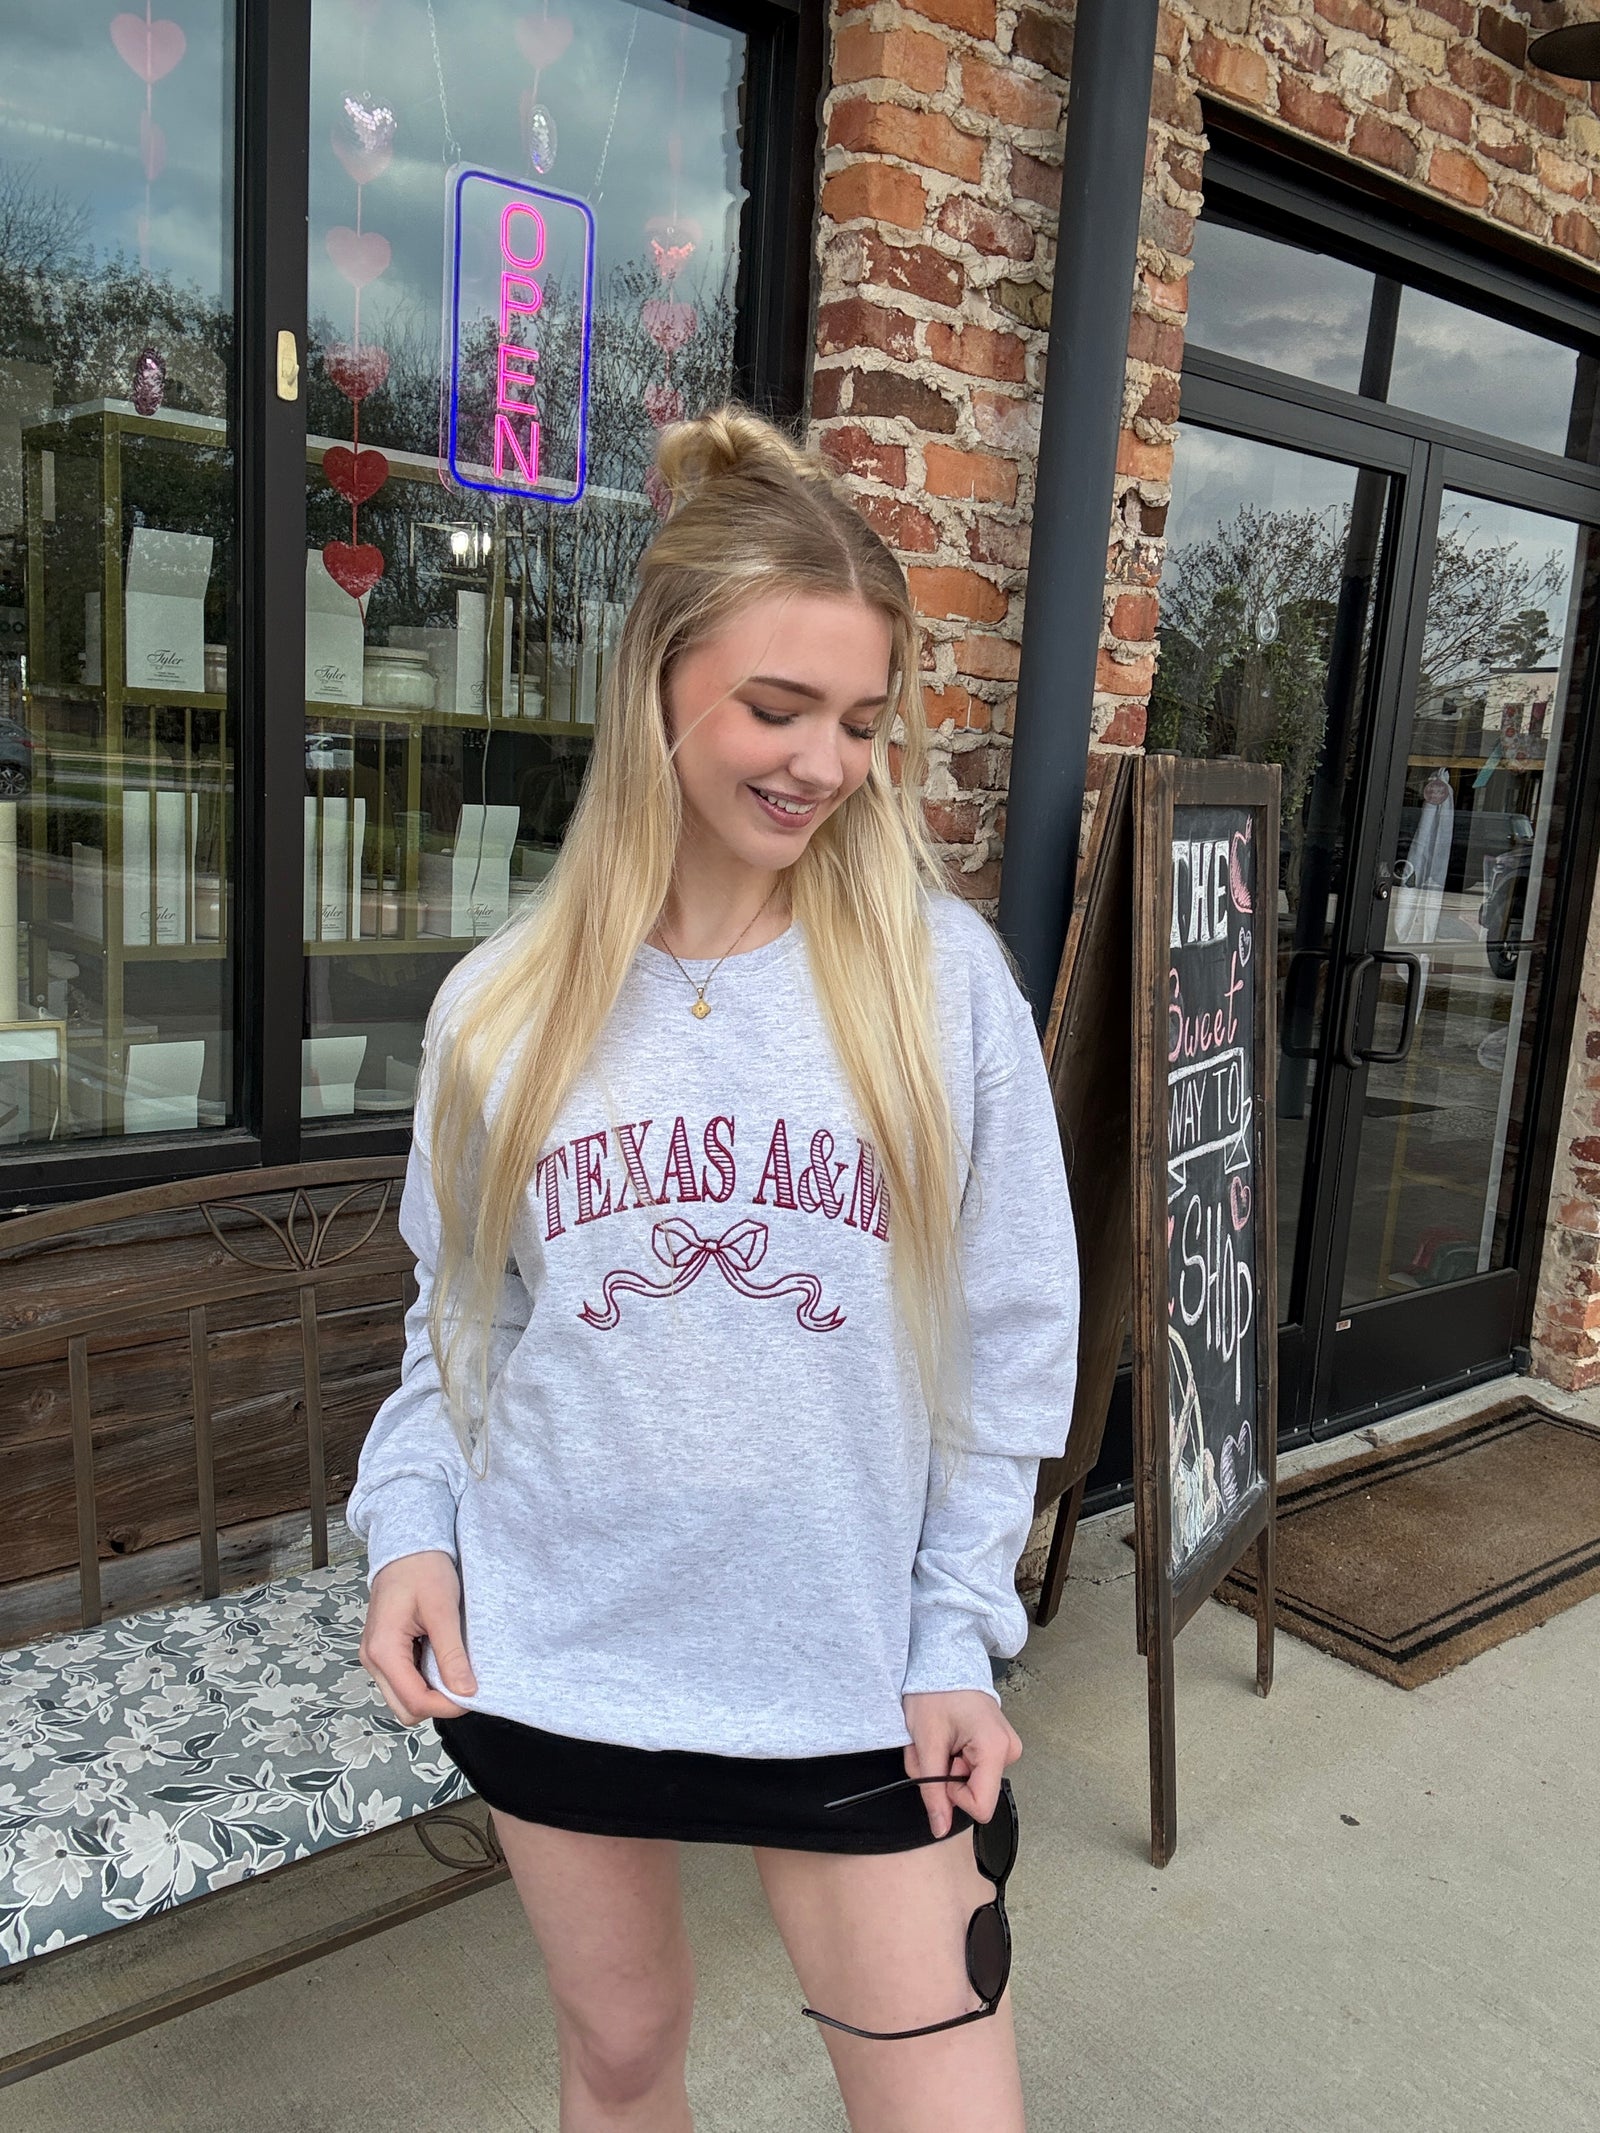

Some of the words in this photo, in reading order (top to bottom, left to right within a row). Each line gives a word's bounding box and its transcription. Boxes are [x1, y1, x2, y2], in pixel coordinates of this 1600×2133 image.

[493, 201, 546, 486] OPEN
[146, 649, 184, 670] Tyler
[314, 664, 346, 684] Tyler
[1170, 840, 1230, 948] THE
[1168, 1071, 1207, 1155] WAY
[1212, 1061, 1240, 1132] TO
[535, 1115, 736, 1242] TEXAS
[752, 1118, 891, 1242] A&M
[1179, 1194, 1254, 1406] SHOP
